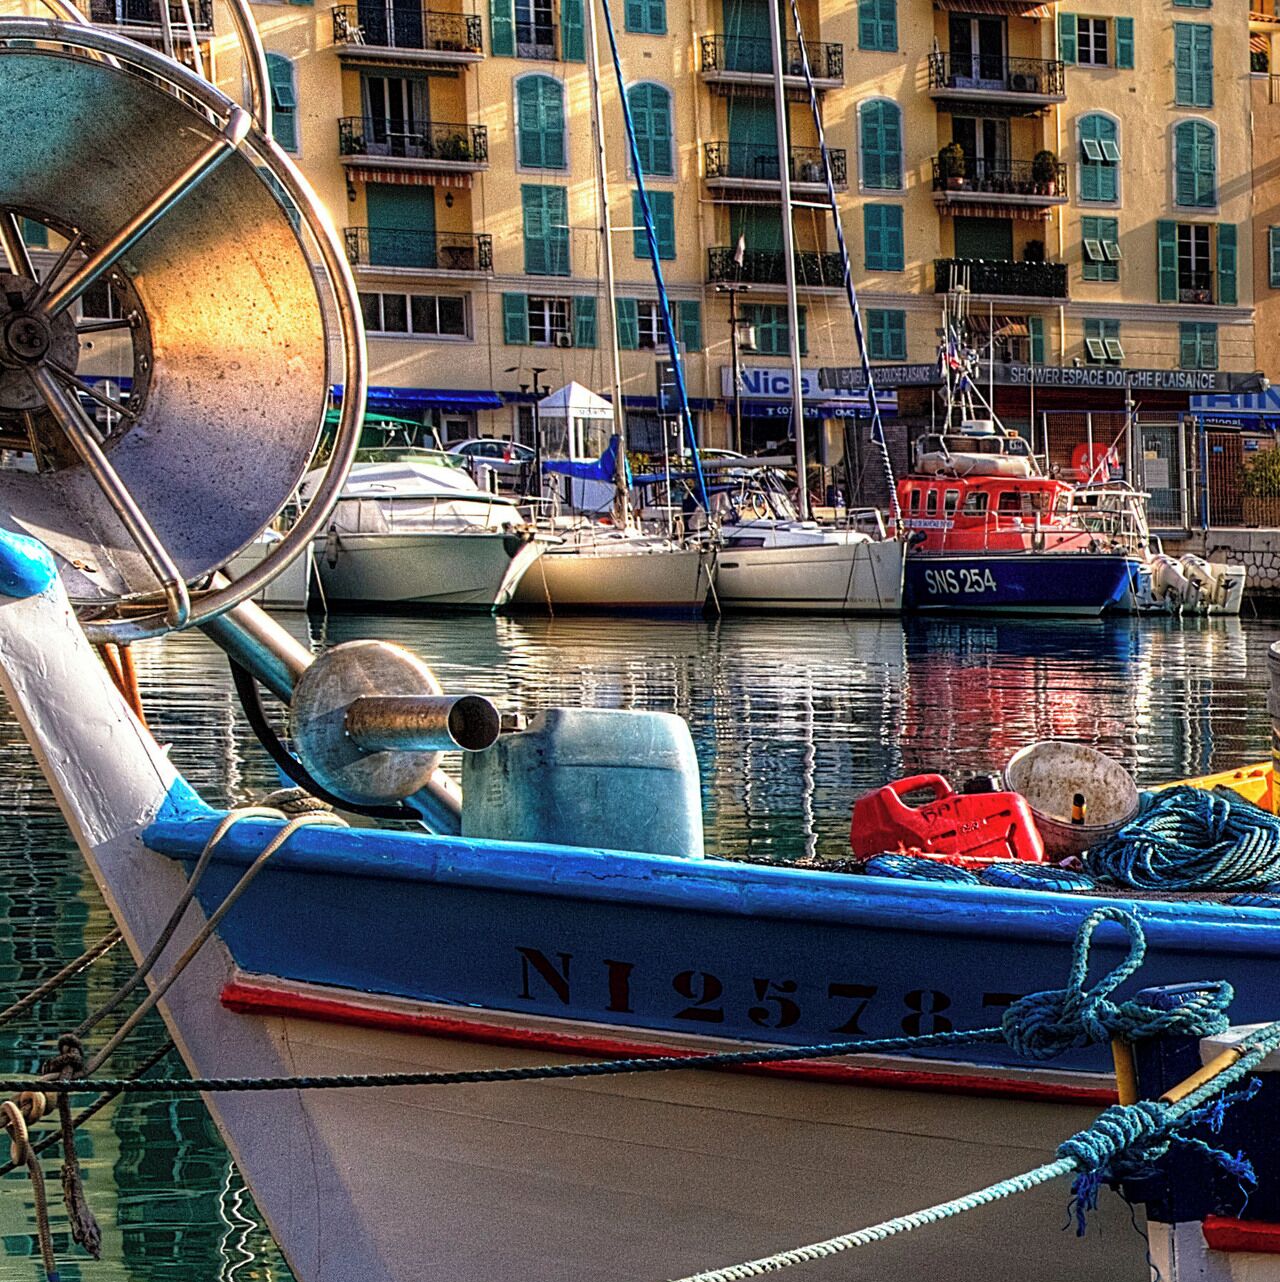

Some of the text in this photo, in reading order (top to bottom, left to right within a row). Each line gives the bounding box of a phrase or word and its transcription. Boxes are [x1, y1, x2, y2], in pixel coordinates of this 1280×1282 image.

[1010, 367, 1060, 384] SHOWER
[1061, 368, 1104, 385] ESPACE
[1155, 372, 1215, 389] PLAISANCE
[925, 568, 997, 594] SNS 254
